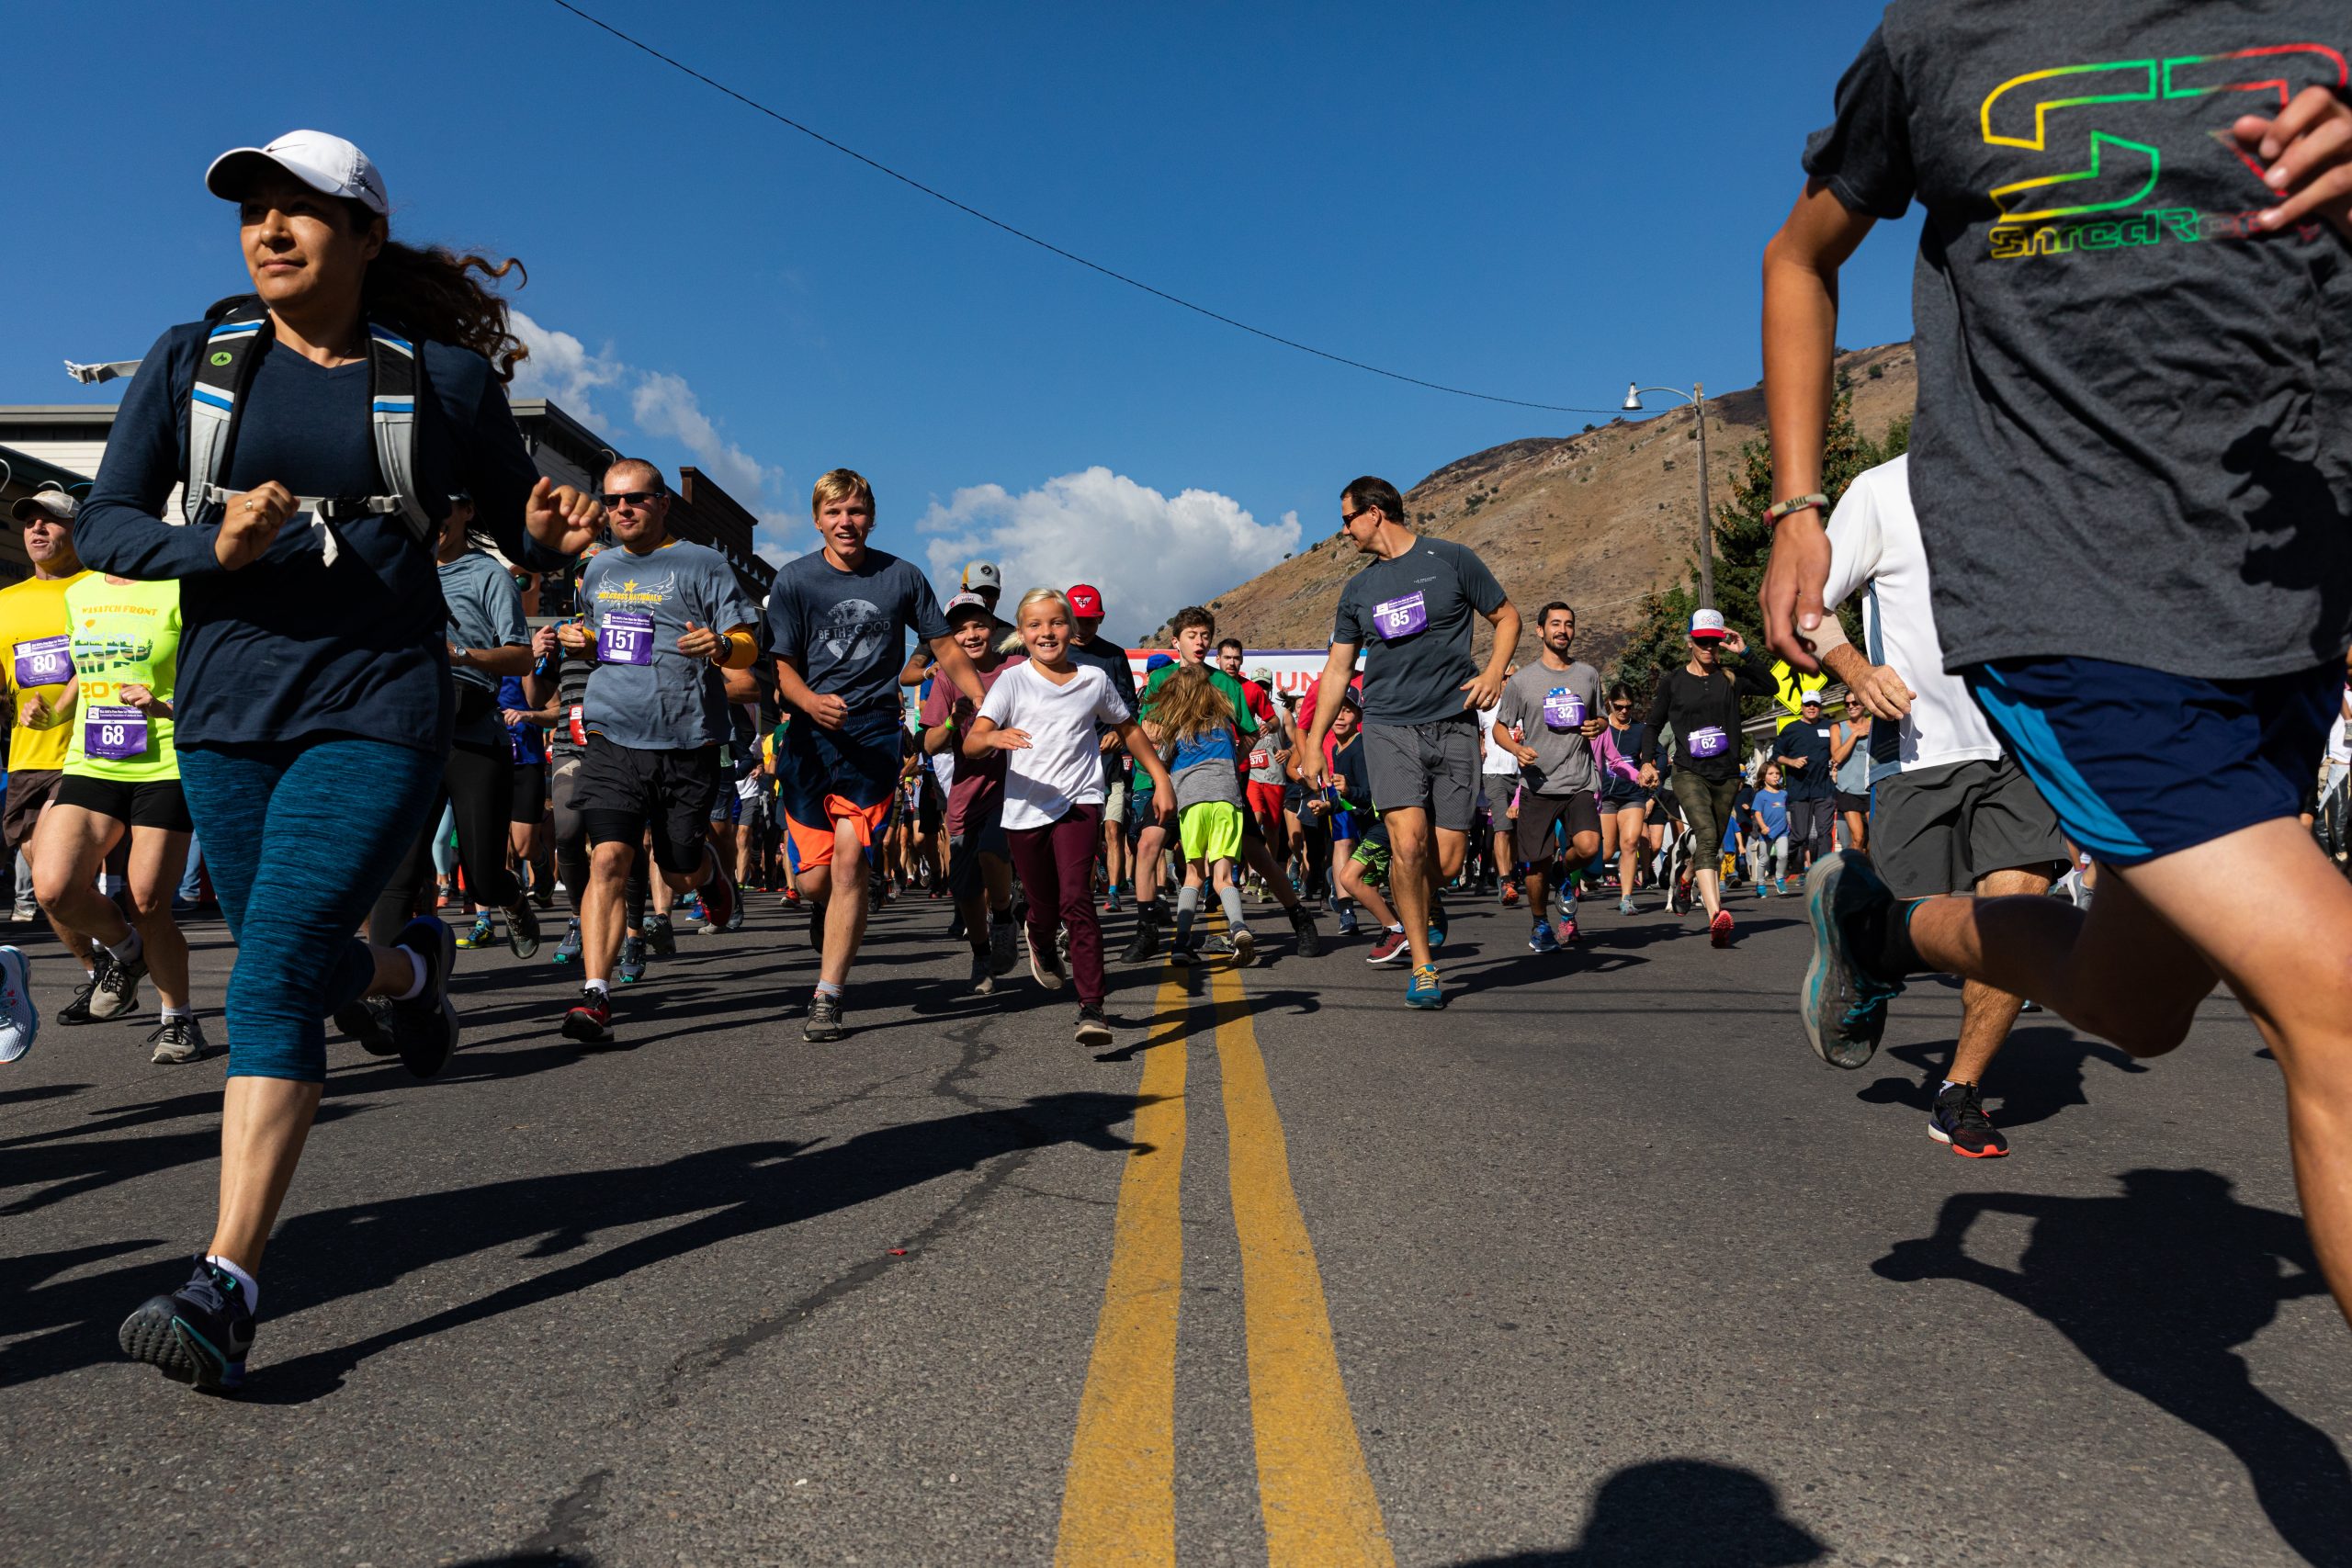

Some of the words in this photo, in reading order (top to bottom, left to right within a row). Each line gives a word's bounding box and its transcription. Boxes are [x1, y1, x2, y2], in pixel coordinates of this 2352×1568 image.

[123, 605, 158, 616] FRONT
[1390, 610, 1409, 627] 85
[605, 629, 635, 650] 151
[819, 629, 830, 640] BE
[833, 626, 852, 638] THE
[33, 653, 57, 673] 80
[1557, 705, 1574, 719] 32
[102, 725, 125, 745] 68
[1701, 737, 1717, 750] 62
